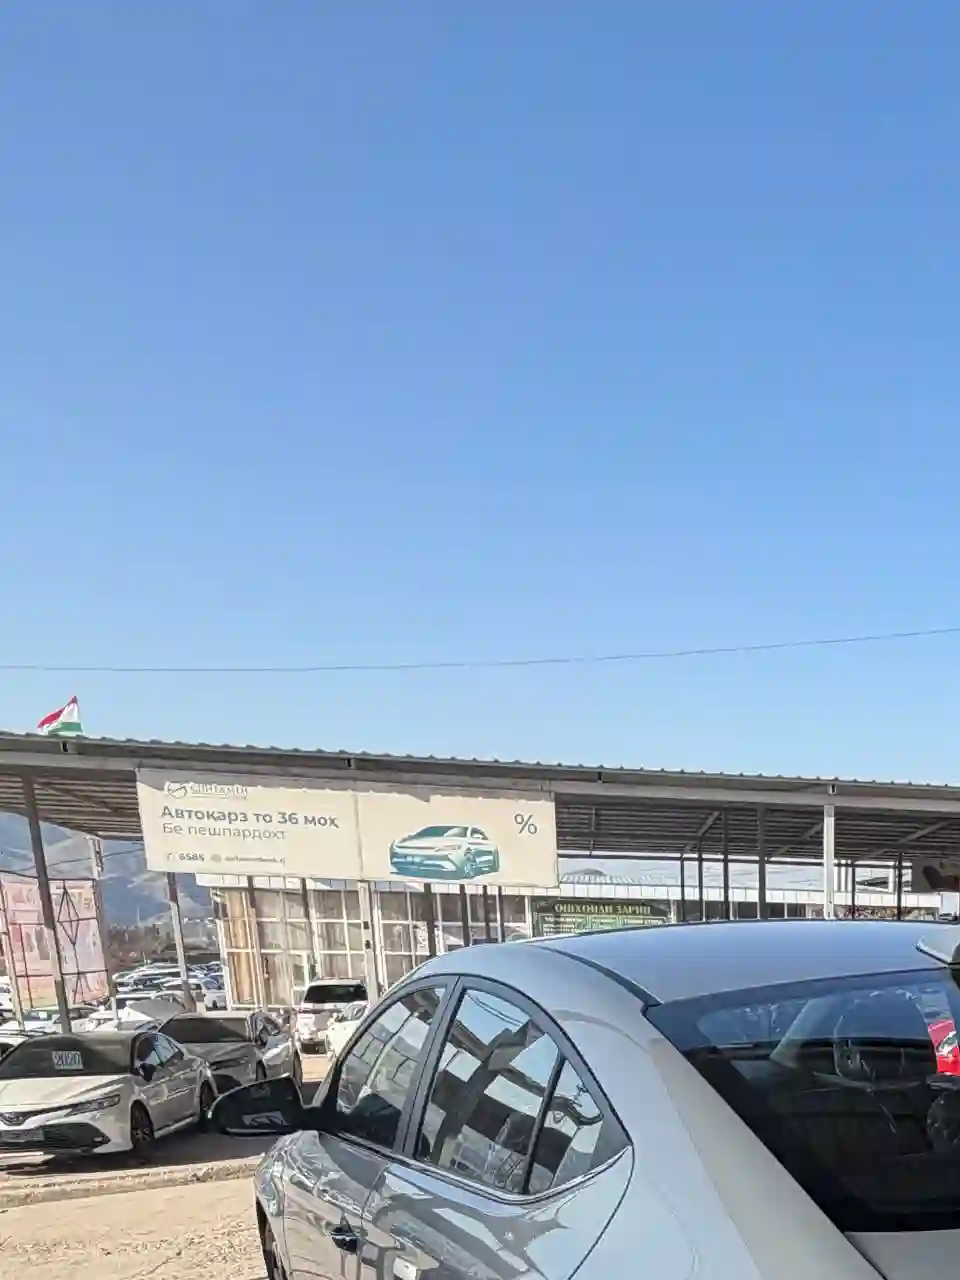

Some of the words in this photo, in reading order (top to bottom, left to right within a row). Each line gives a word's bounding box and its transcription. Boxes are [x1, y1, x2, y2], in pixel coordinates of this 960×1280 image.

[161, 805, 248, 825] Автоқарз
[254, 812, 273, 824] то
[277, 811, 299, 826] 36
[514, 813, 538, 834] %
[162, 822, 183, 835] Бе
[188, 825, 287, 841] пешпардохт
